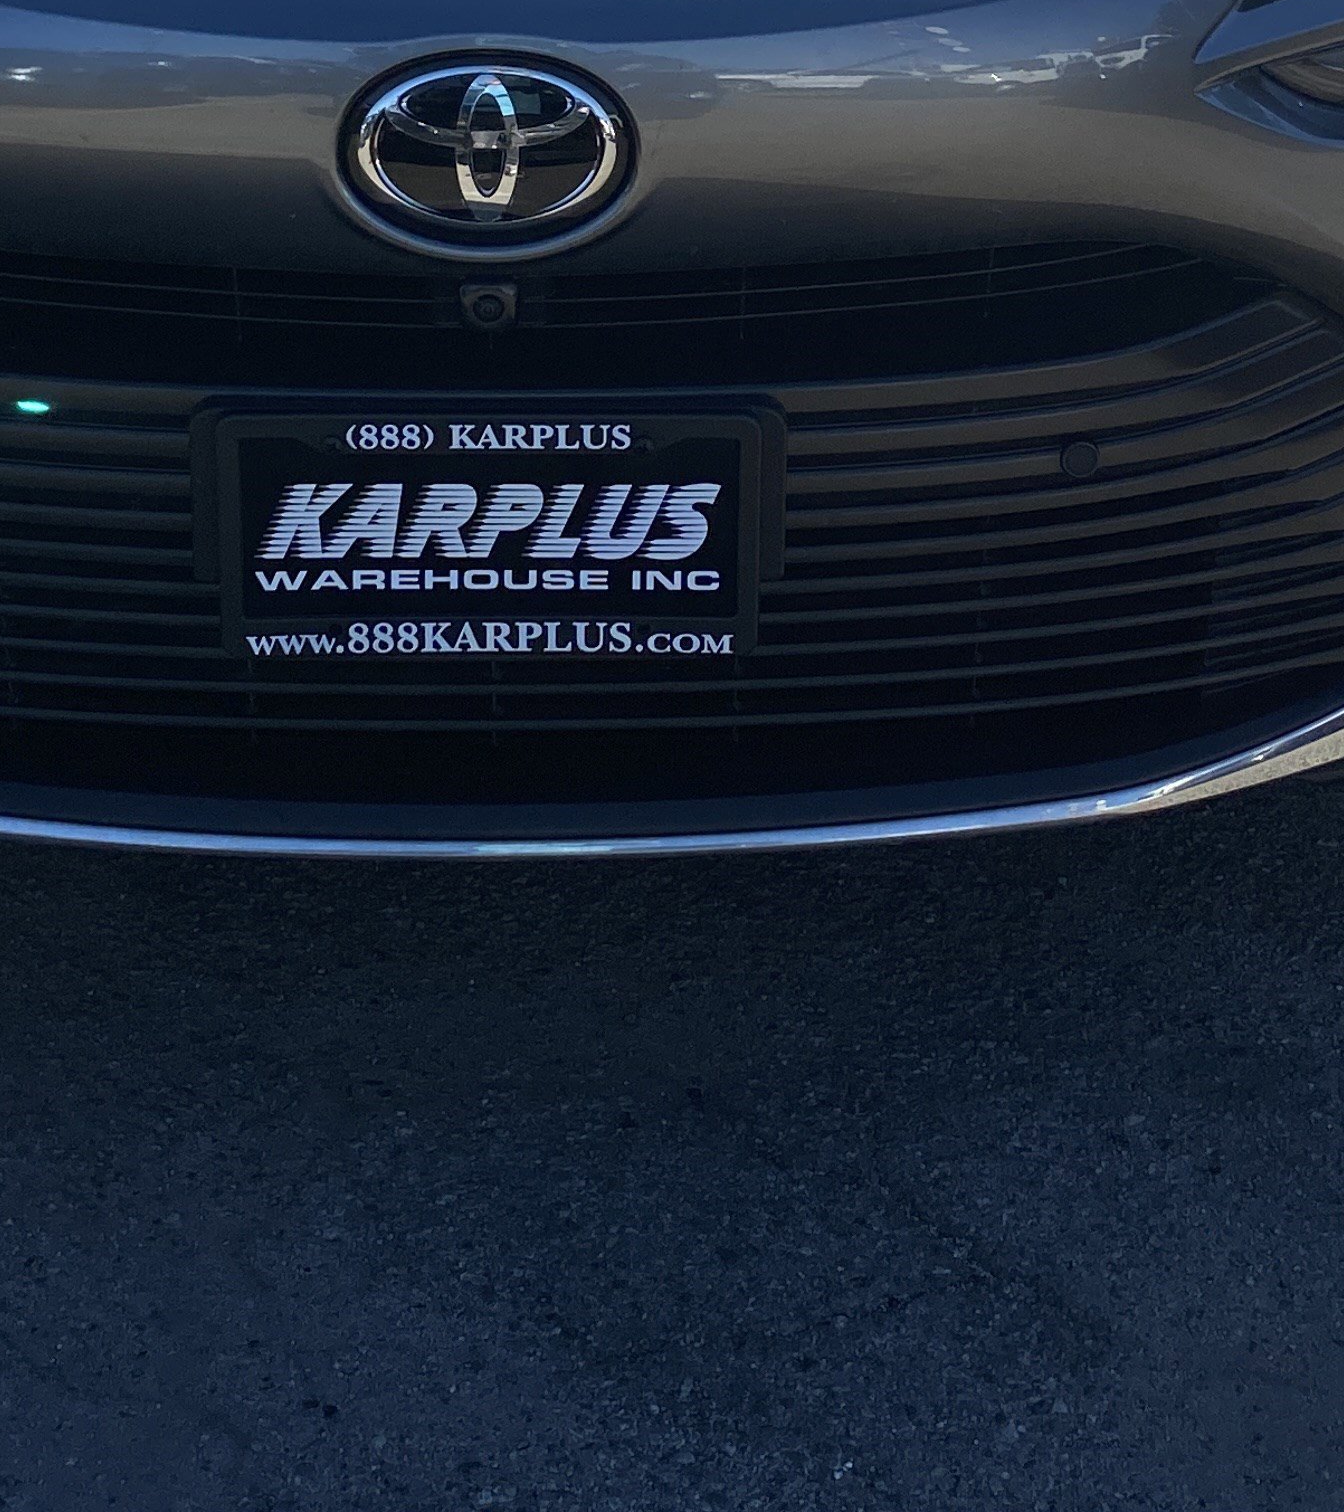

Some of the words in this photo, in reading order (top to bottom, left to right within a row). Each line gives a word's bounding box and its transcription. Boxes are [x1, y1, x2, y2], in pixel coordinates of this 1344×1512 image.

[344, 424, 436, 452] (888)
[448, 424, 632, 452] KARPLUS
[254, 482, 723, 561] KARPLUS
[254, 569, 610, 592] WAREHOUSE
[631, 569, 721, 592] INC
